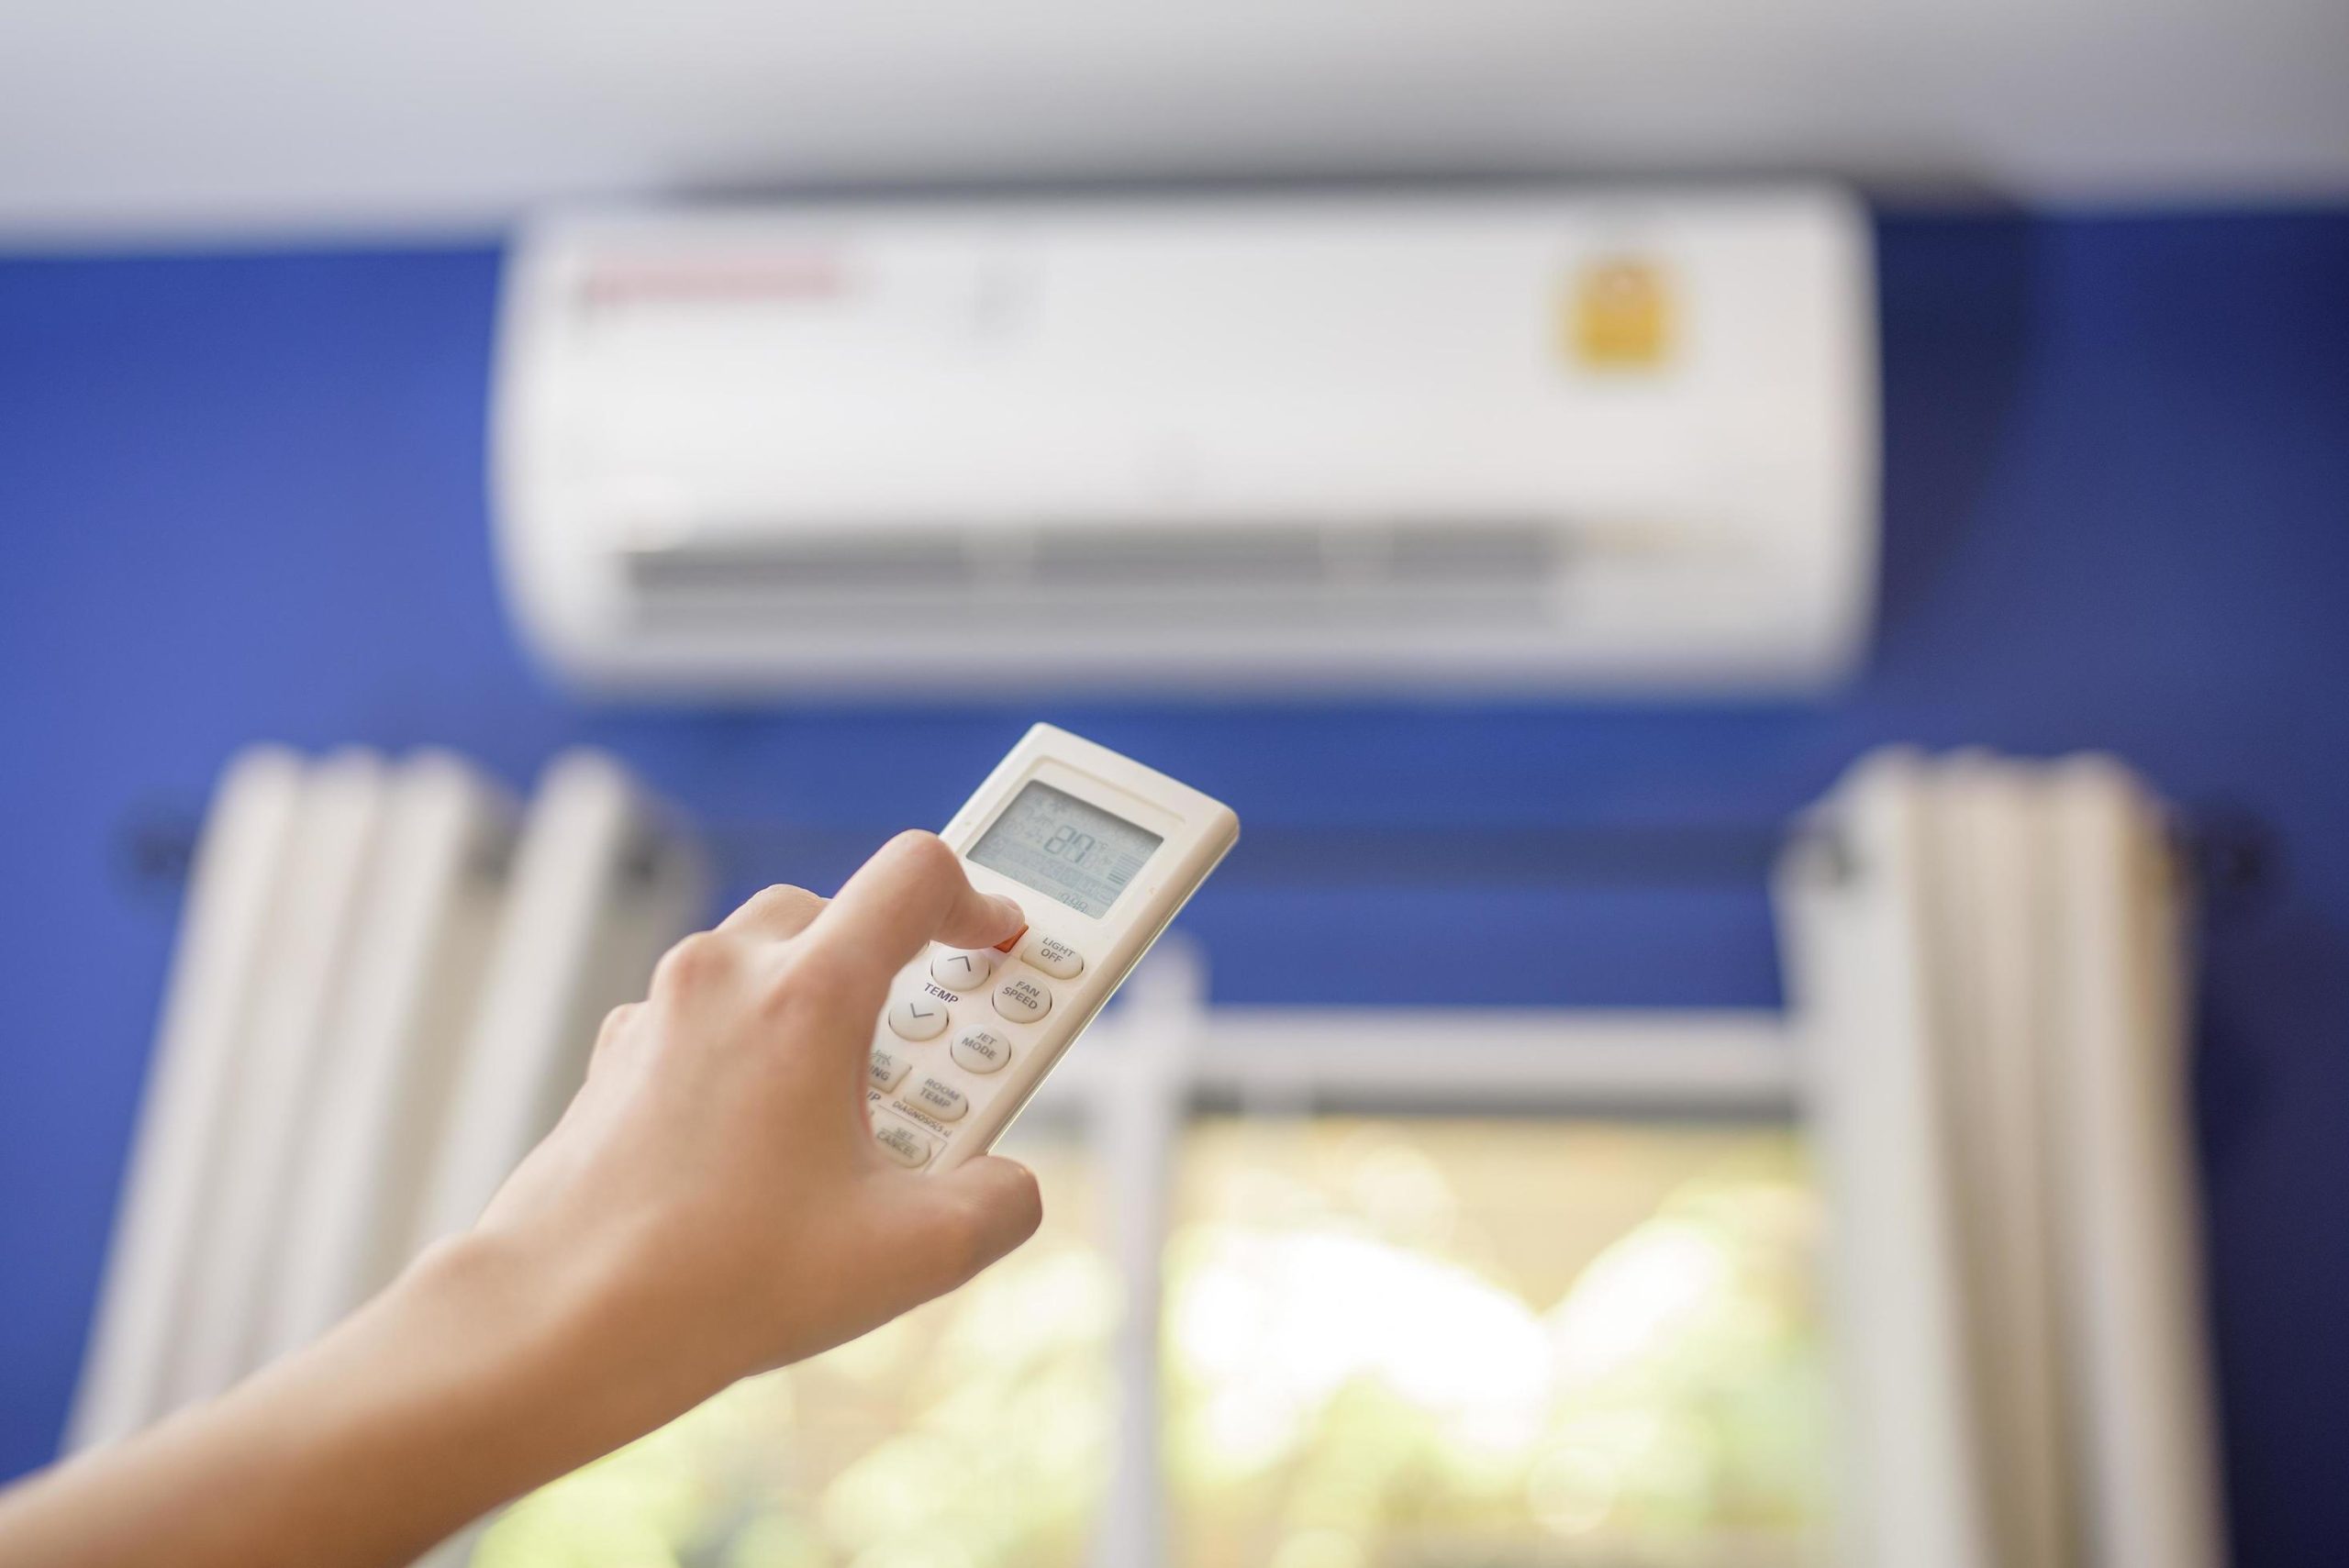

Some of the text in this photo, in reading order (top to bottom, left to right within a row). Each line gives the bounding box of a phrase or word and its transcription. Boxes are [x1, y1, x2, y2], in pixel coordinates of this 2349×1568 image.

[1041, 948, 1063, 962] OFF
[1042, 937, 1075, 957] LIGHT
[924, 983, 959, 1003] TEMP
[1002, 987, 1038, 1010] SPEED
[1016, 981, 1041, 997] FAN
[962, 1037, 996, 1060] MODE
[976, 1032, 997, 1045] JET
[920, 1087, 952, 1107] TEMP
[925, 1078, 961, 1101] ROOM
